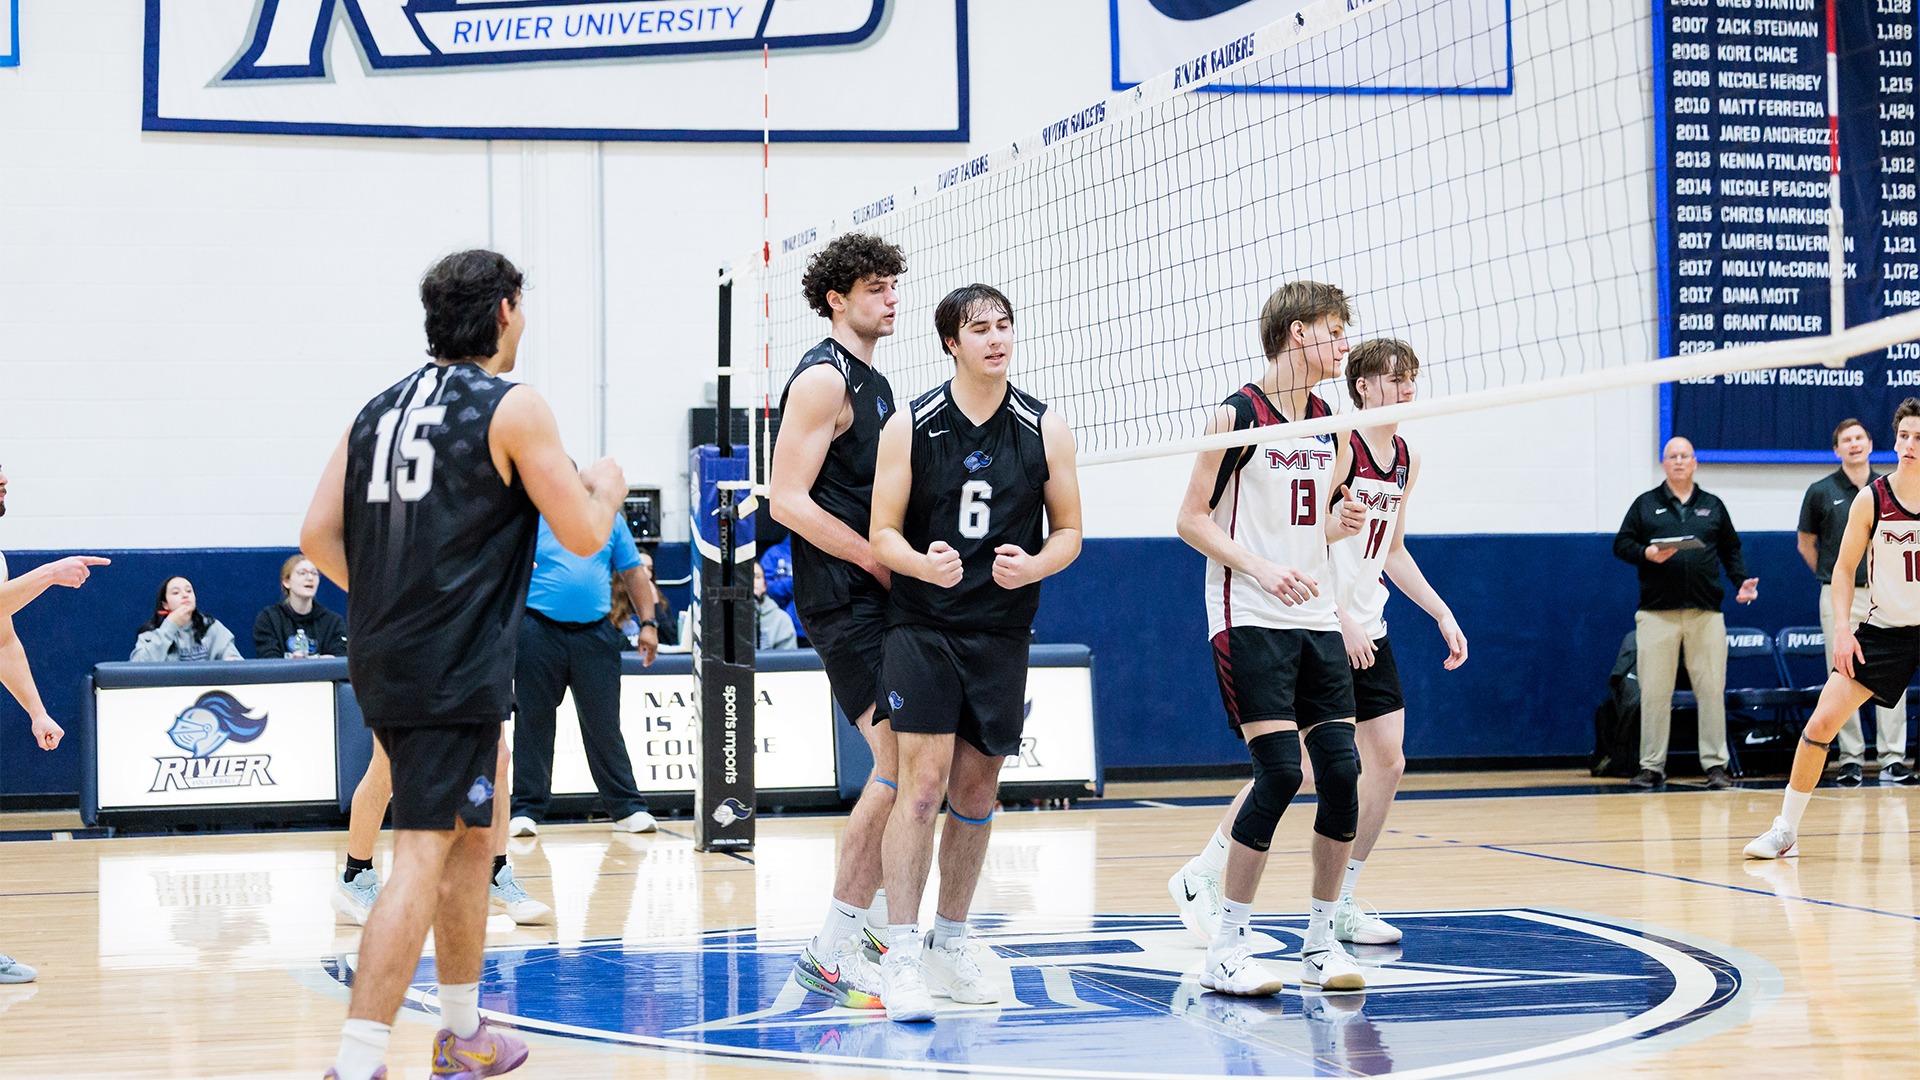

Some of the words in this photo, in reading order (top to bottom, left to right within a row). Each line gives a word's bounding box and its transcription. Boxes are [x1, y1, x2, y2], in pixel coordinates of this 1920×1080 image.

[453, 16, 552, 44] RIVIER
[565, 6, 743, 37] UNIVERSITY
[1673, 17, 1708, 33] 2007
[1717, 18, 1750, 34] ZACK
[1754, 20, 1818, 37] STEDMAN
[1718, 45, 1751, 61] KORI
[1755, 46, 1797, 63] CHACE
[1880, 50, 1911, 67] 1,110
[1719, 72, 1767, 88] NICOLE
[1770, 73, 1821, 90] HERSEY
[1880, 77, 1912, 94] 1,215
[1675, 97, 1709, 113] 2010
[1719, 98, 1756, 115] MATT
[1759, 100, 1824, 117] FERREIRA
[1880, 104, 1914, 120] 1,424
[1677, 124, 1710, 140] 2011
[1720, 125, 1760, 142] JARED
[1881, 130, 1914, 146] 1,810
[1676, 151, 1710, 167] 2013
[1720, 153, 1764, 169] KENNA
[1677, 179, 1711, 195] 2014
[1721, 180, 1769, 196] NICOLE
[1677, 206, 1712, 221] 2015
[1721, 206, 1764, 223] CHRIS
[1766, 207, 1843, 225] MARKUSO
[1679, 233, 1712, 249] 2017
[1722, 233, 1773, 250] LAUREN
[1775, 233, 1854, 253] SILVERMN
[1884, 237, 1916, 254] 1,121
[1679, 260, 1712, 276] 2017
[1722, 260, 1765, 276] MOLLY
[1884, 263, 1918, 280] 1,072
[1680, 287, 1713, 303] 2017
[1723, 287, 1759, 303] DANA
[1761, 288, 1799, 304] MOTT
[1680, 314, 1713, 330] 2018
[1724, 314, 1768, 330] GRANT
[1770, 315, 1821, 331] ANDLER
[1724, 370, 1778, 385] SYDNEY
[1779, 368, 1864, 386] RACEVICIUS
[367, 405, 448, 503] 15
[1265, 449, 1333, 470] MIT
[958, 480, 993, 539] 6
[1291, 479, 1317, 526] 13
[1356, 489, 1402, 512] MIT
[1363, 518, 1388, 559] 11
[1880, 530, 1920, 545] M
[1726, 634, 1764, 647] IVIER
[1787, 633, 1825, 649] RIVIE
[722, 685, 737, 729] sports
[645, 716, 672, 733] IS
[722, 731, 737, 785] imports
[147, 754, 277, 793] RIVIER
